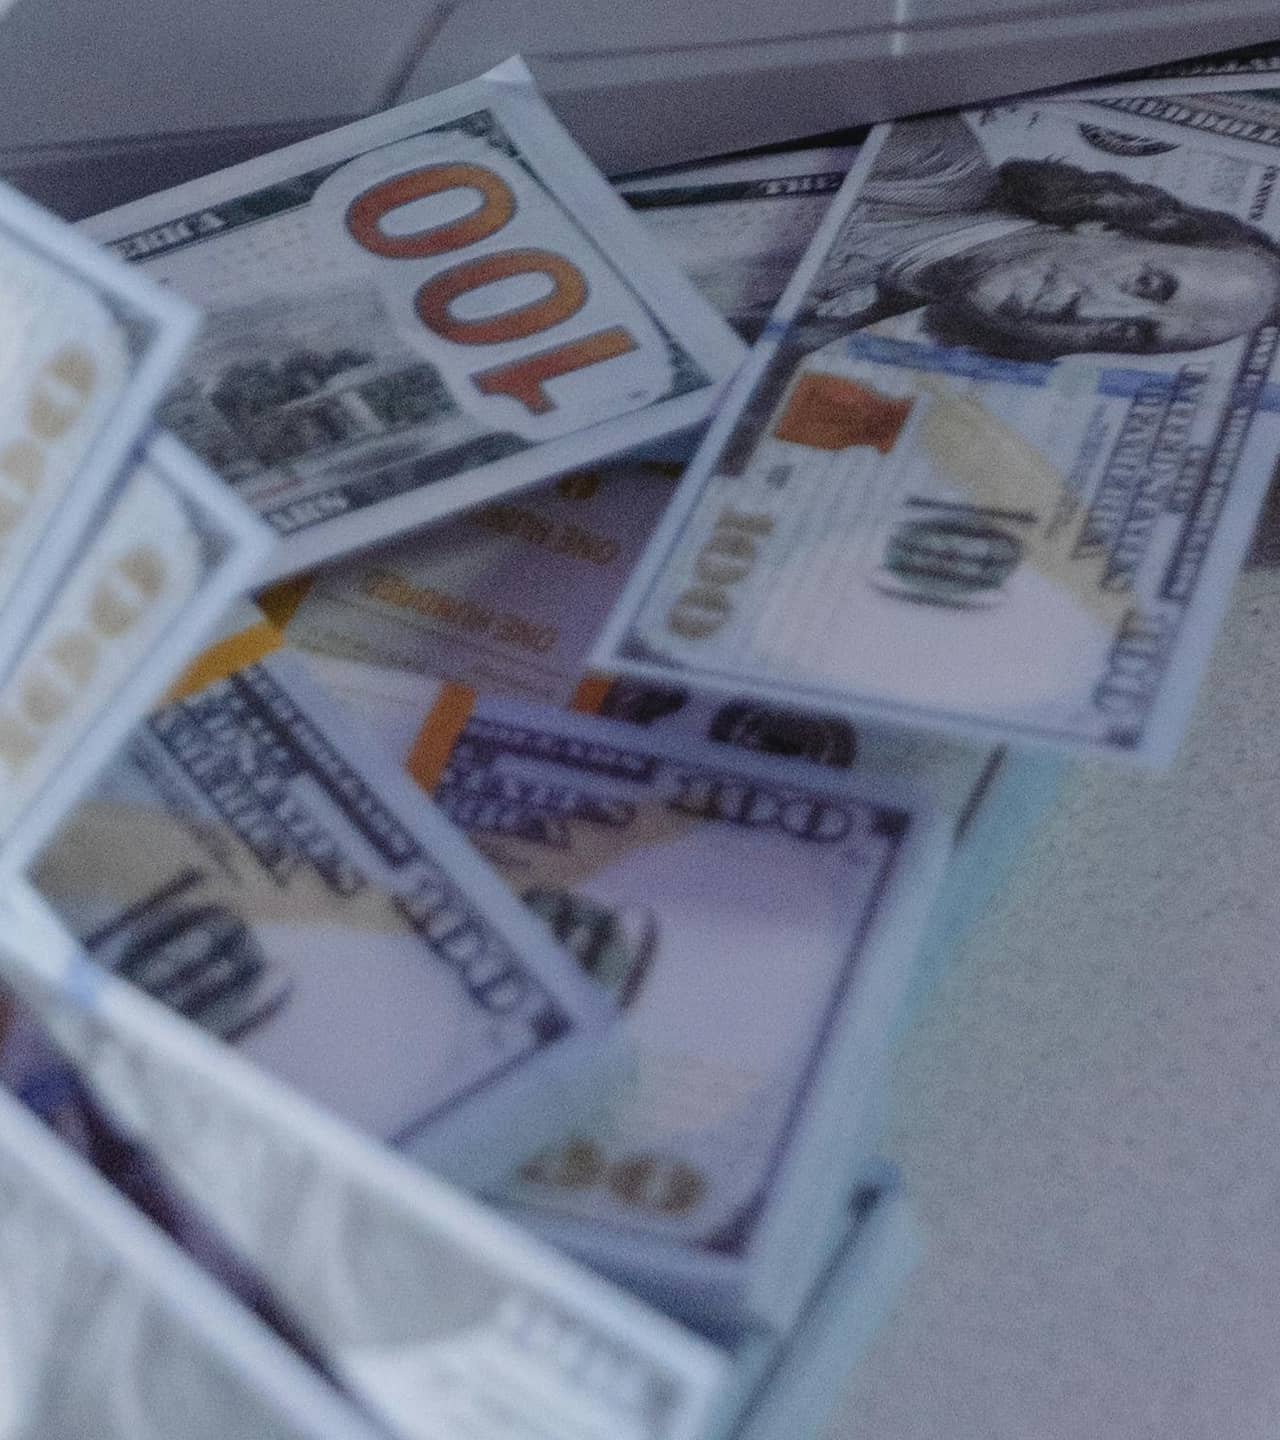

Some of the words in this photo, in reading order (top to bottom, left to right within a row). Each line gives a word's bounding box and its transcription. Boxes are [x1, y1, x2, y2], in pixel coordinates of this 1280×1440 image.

[346, 160, 640, 416] 100
[662, 509, 780, 645] 100
[868, 503, 1039, 612] 100
[1099, 467, 1171, 598] STATES
[491, 610, 561, 654] ONE
[667, 769, 856, 850] 100
[389, 869, 524, 1018] 100
